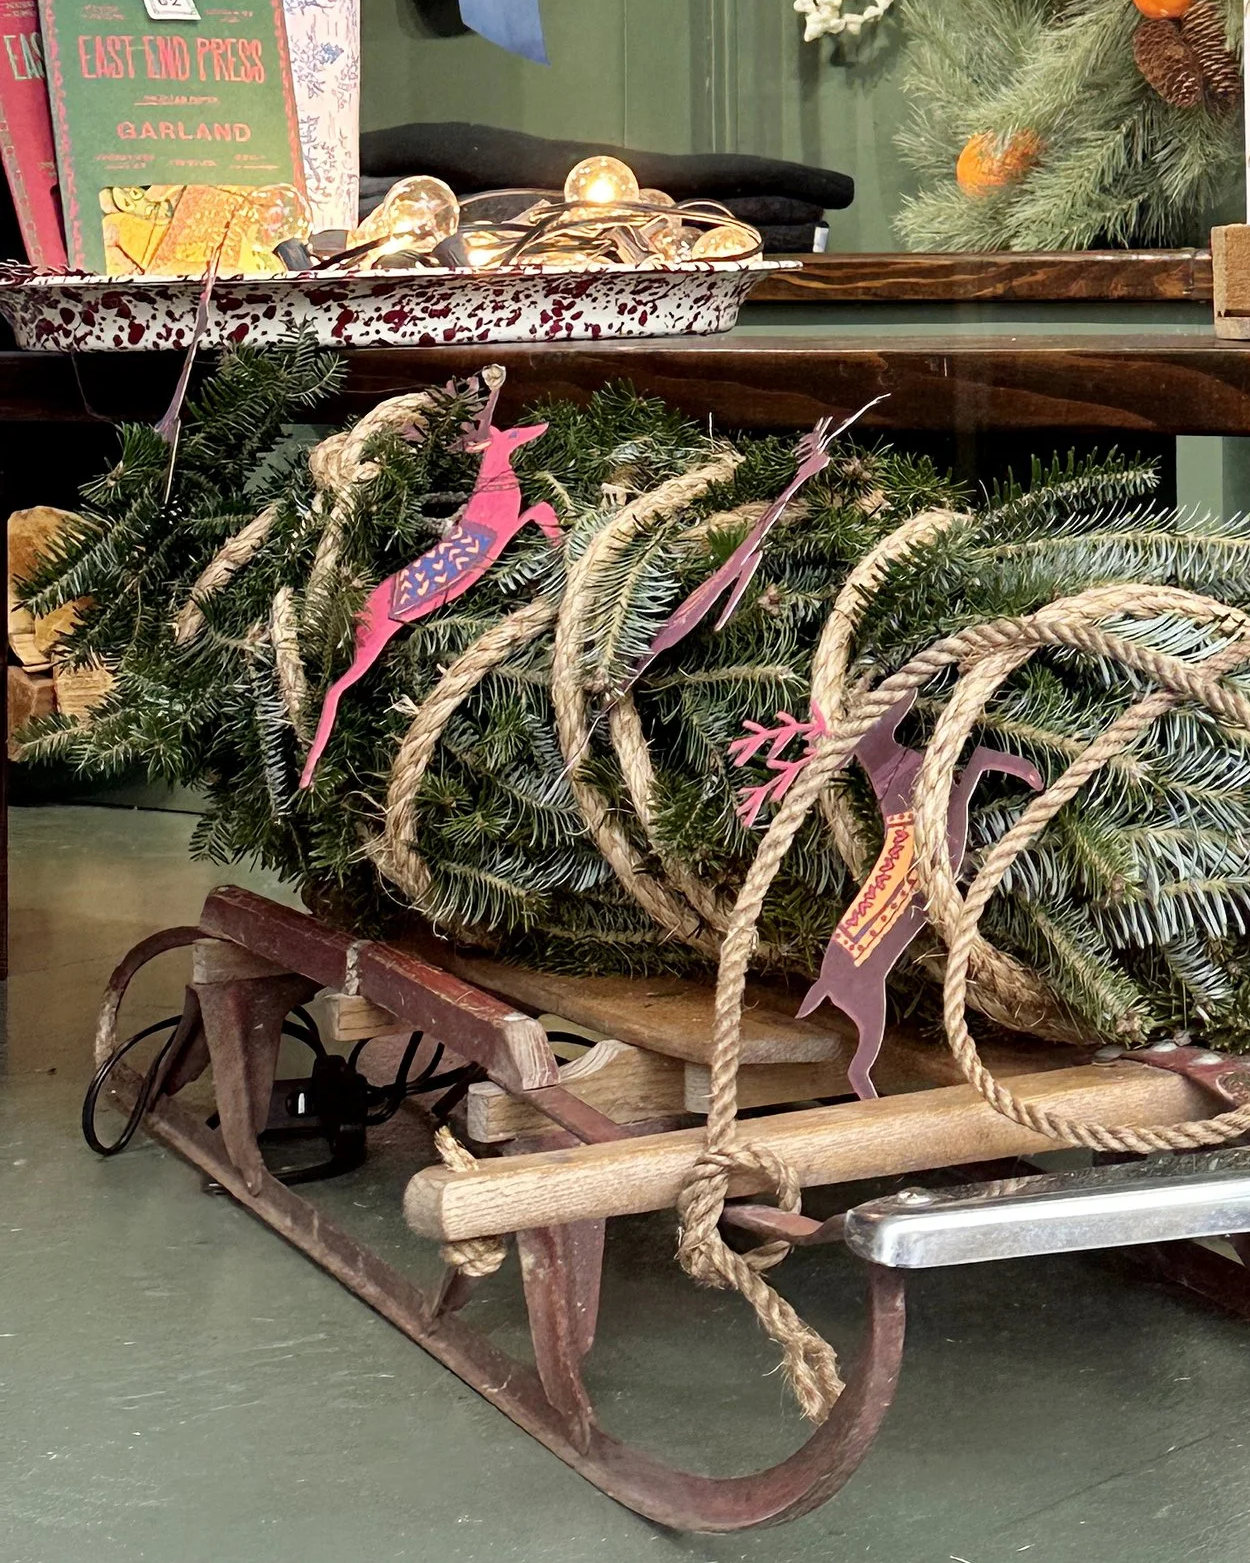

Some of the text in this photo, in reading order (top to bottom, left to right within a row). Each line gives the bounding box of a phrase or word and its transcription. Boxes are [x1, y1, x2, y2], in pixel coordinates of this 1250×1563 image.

[78, 35, 266, 84] EAST END PRESS
[116, 121, 252, 142] GARLAND
